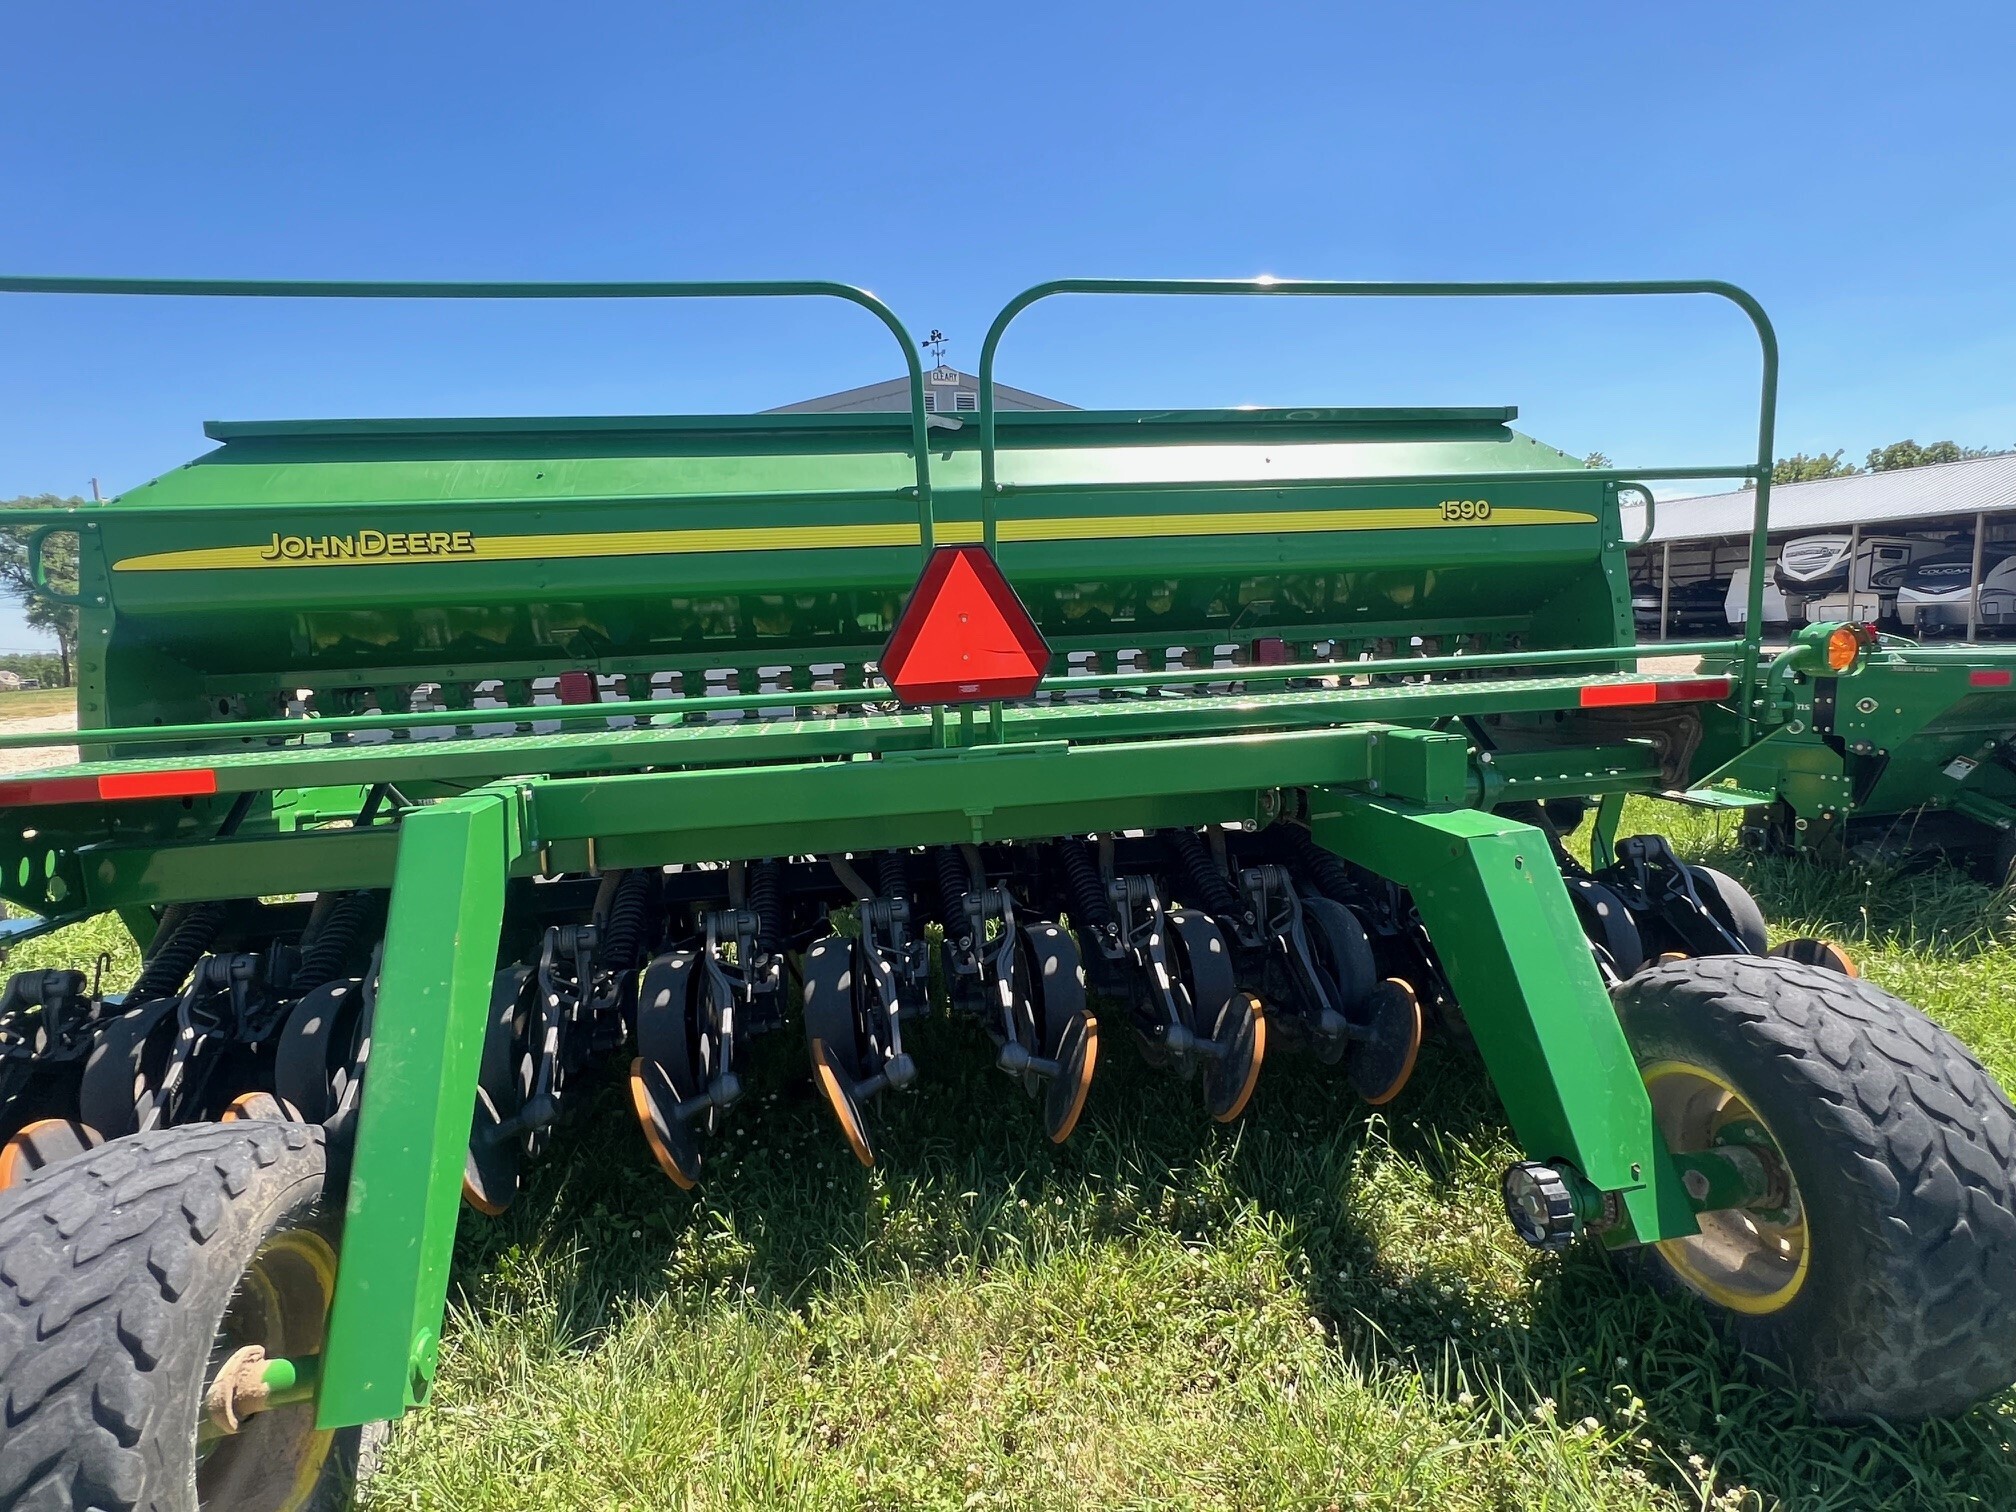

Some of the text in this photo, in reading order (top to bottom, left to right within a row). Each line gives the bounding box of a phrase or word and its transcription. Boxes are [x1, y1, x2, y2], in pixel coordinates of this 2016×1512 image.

[932, 372, 957, 382] CLEARY
[1439, 500, 1490, 519] 1590
[261, 529, 475, 559] JOHN DEERE
[1918, 568, 1971, 576] COUGAR
